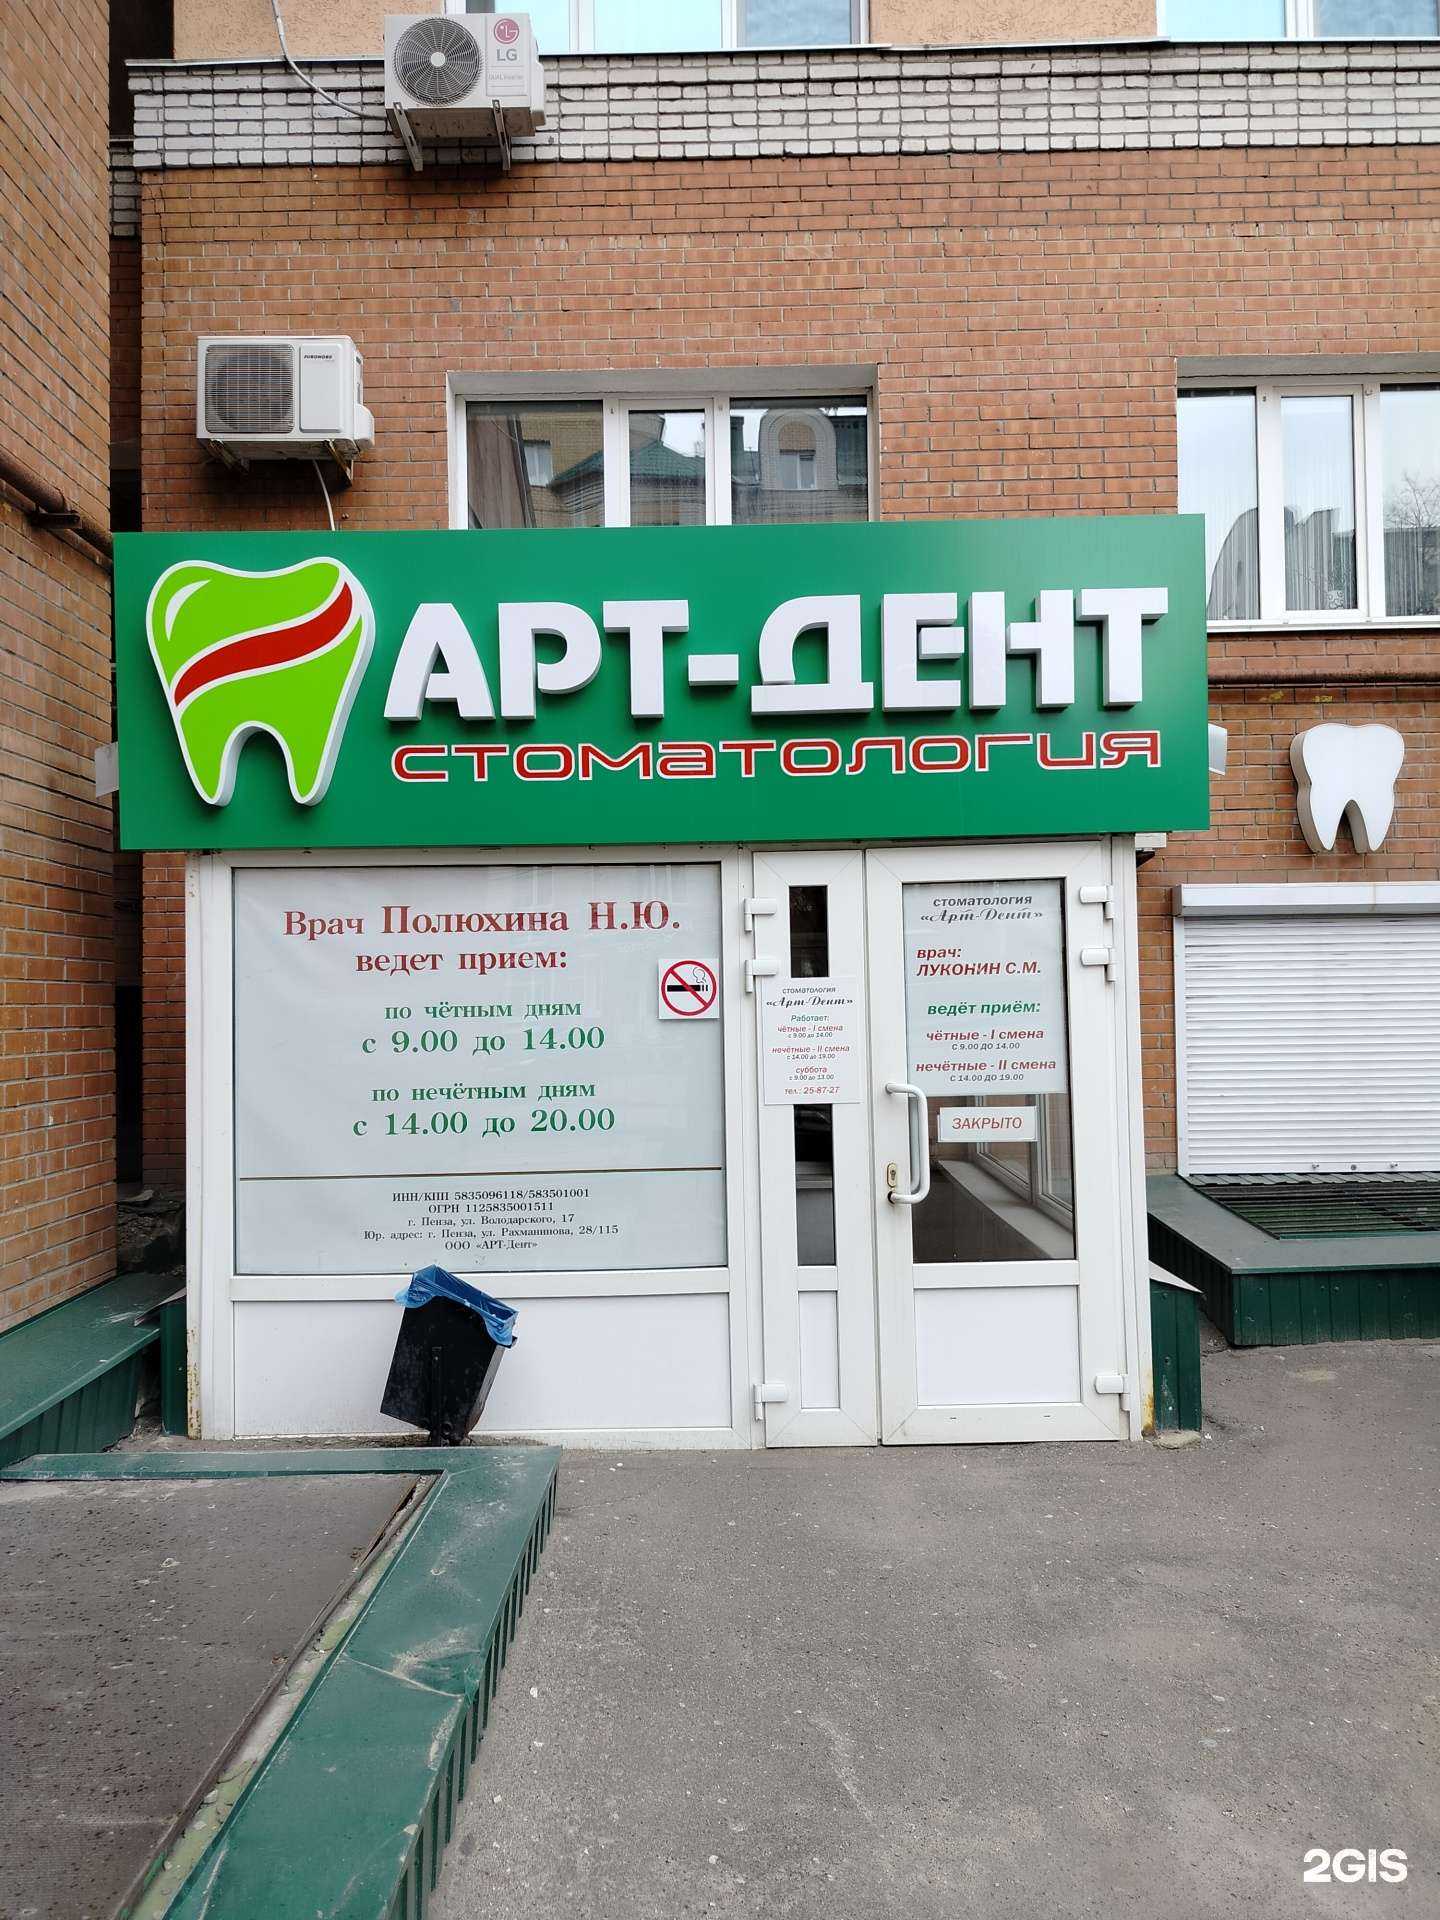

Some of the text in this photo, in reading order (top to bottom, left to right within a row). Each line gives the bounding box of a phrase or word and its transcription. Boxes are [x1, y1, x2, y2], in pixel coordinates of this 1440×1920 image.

[496, 48, 518, 61] LG
[383, 587, 1168, 721] АРТ-ДЕНТ
[933, 896, 1032, 906] стоматология
[283, 899, 681, 941] Врач Полюхина Н.Ю.
[917, 948, 961, 960] врач:
[355, 950, 568, 976] ведет прием:
[917, 961, 1040, 976] ЛУКОНИН С.М.
[384, 1001, 581, 1022] по чётным дням
[928, 1001, 1040, 1016] ведёт приём:
[362, 1026, 605, 1056] с 9.00 до 14.00
[927, 1030, 979, 1040] чётные
[999, 1030, 1044, 1039] смена
[916, 1061, 987, 1072] нечётные
[1011, 1060, 1056, 1070] смена
[371, 1081, 596, 1103] по нечётным дням
[353, 1108, 615, 1139] с 14.00 до 20.00
[952, 1117, 1022, 1129] ЗАКРЫТО
[428, 1202, 553, 1213] ОГРН 1125835001511
[421, 1217, 456, 1228] Пенза,
[461, 1218, 475, 1227] ул.
[481, 1215, 555, 1226] Володарского,
[561, 1214, 574, 1223] 17
[364, 1225, 618, 1241] Юр. адрес: г. Пенза, ул. Рахманинова, 28/115
[445, 1240, 470, 1250] ООО
